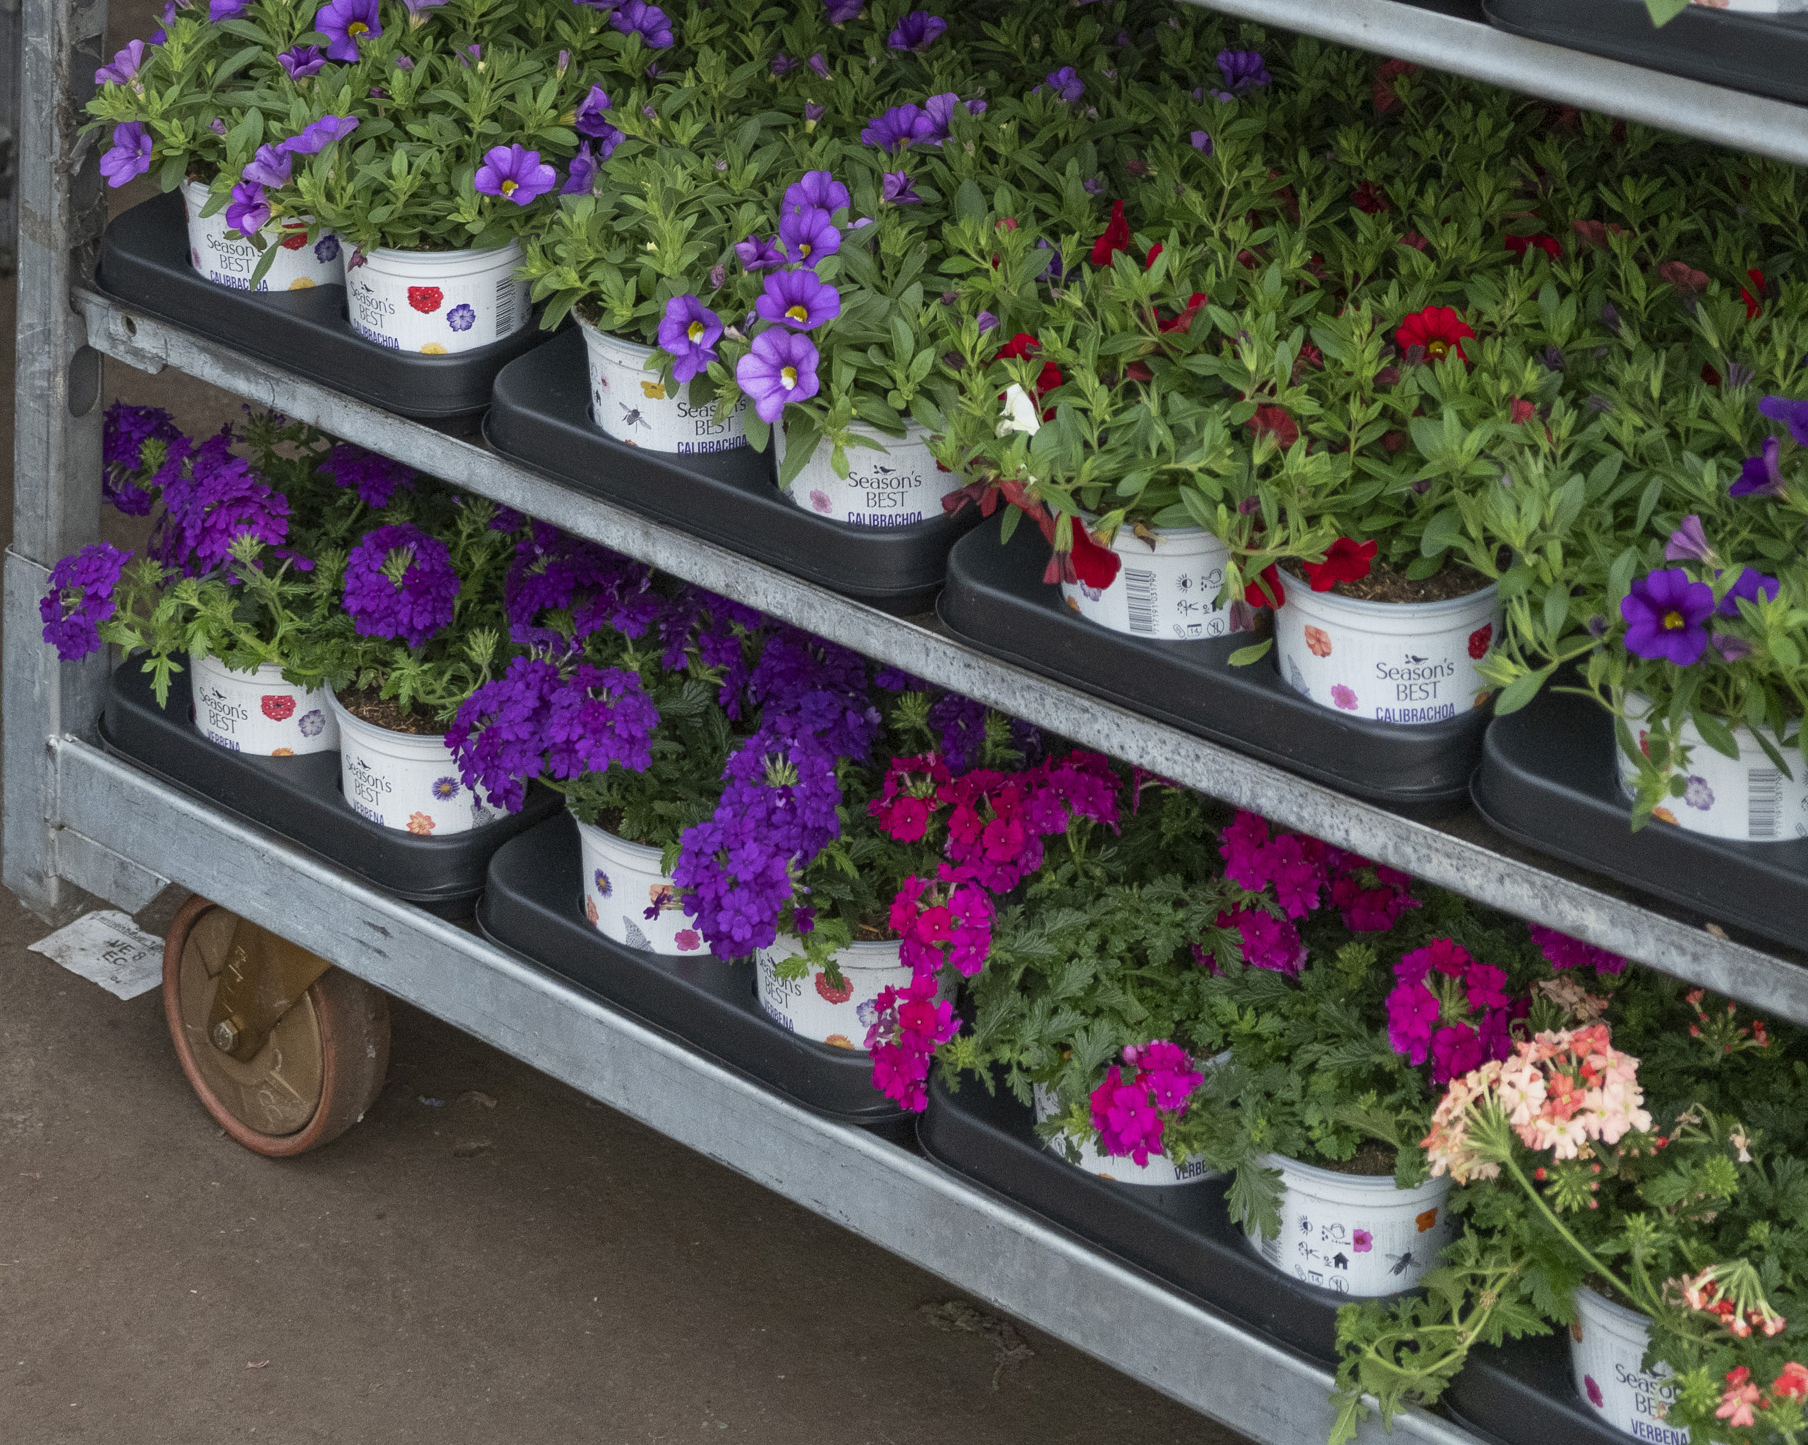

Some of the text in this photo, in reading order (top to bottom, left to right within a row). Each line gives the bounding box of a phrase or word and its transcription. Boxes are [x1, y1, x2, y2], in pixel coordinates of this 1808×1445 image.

[206, 234, 265, 258] Season's
[219, 253, 252, 274] BEST
[349, 288, 396, 315] Season's
[358, 305, 385, 328] BEST
[352, 317, 400, 350] CALIBRACHOA
[694, 418, 732, 436] BEST
[848, 471, 922, 490] Season's
[866, 491, 909, 508] BEST
[847, 512, 923, 527] CALIBRACHOA
[1376, 659, 1454, 681] Season's
[1396, 681, 1438, 701] BEST
[199, 687, 248, 722] Season's
[1376, 705, 1456, 723] CALIBRACHOA
[208, 712, 237, 734] BEST
[207, 728, 240, 752] VERBENA
[346, 761, 392, 793] Season's
[354, 782, 381, 805] BEST
[352, 799, 384, 826] VERBENA
[765, 980, 790, 1008] BEST
[763, 999, 794, 1031] VERBENA
[1174, 1159, 1209, 1181] VERBE
